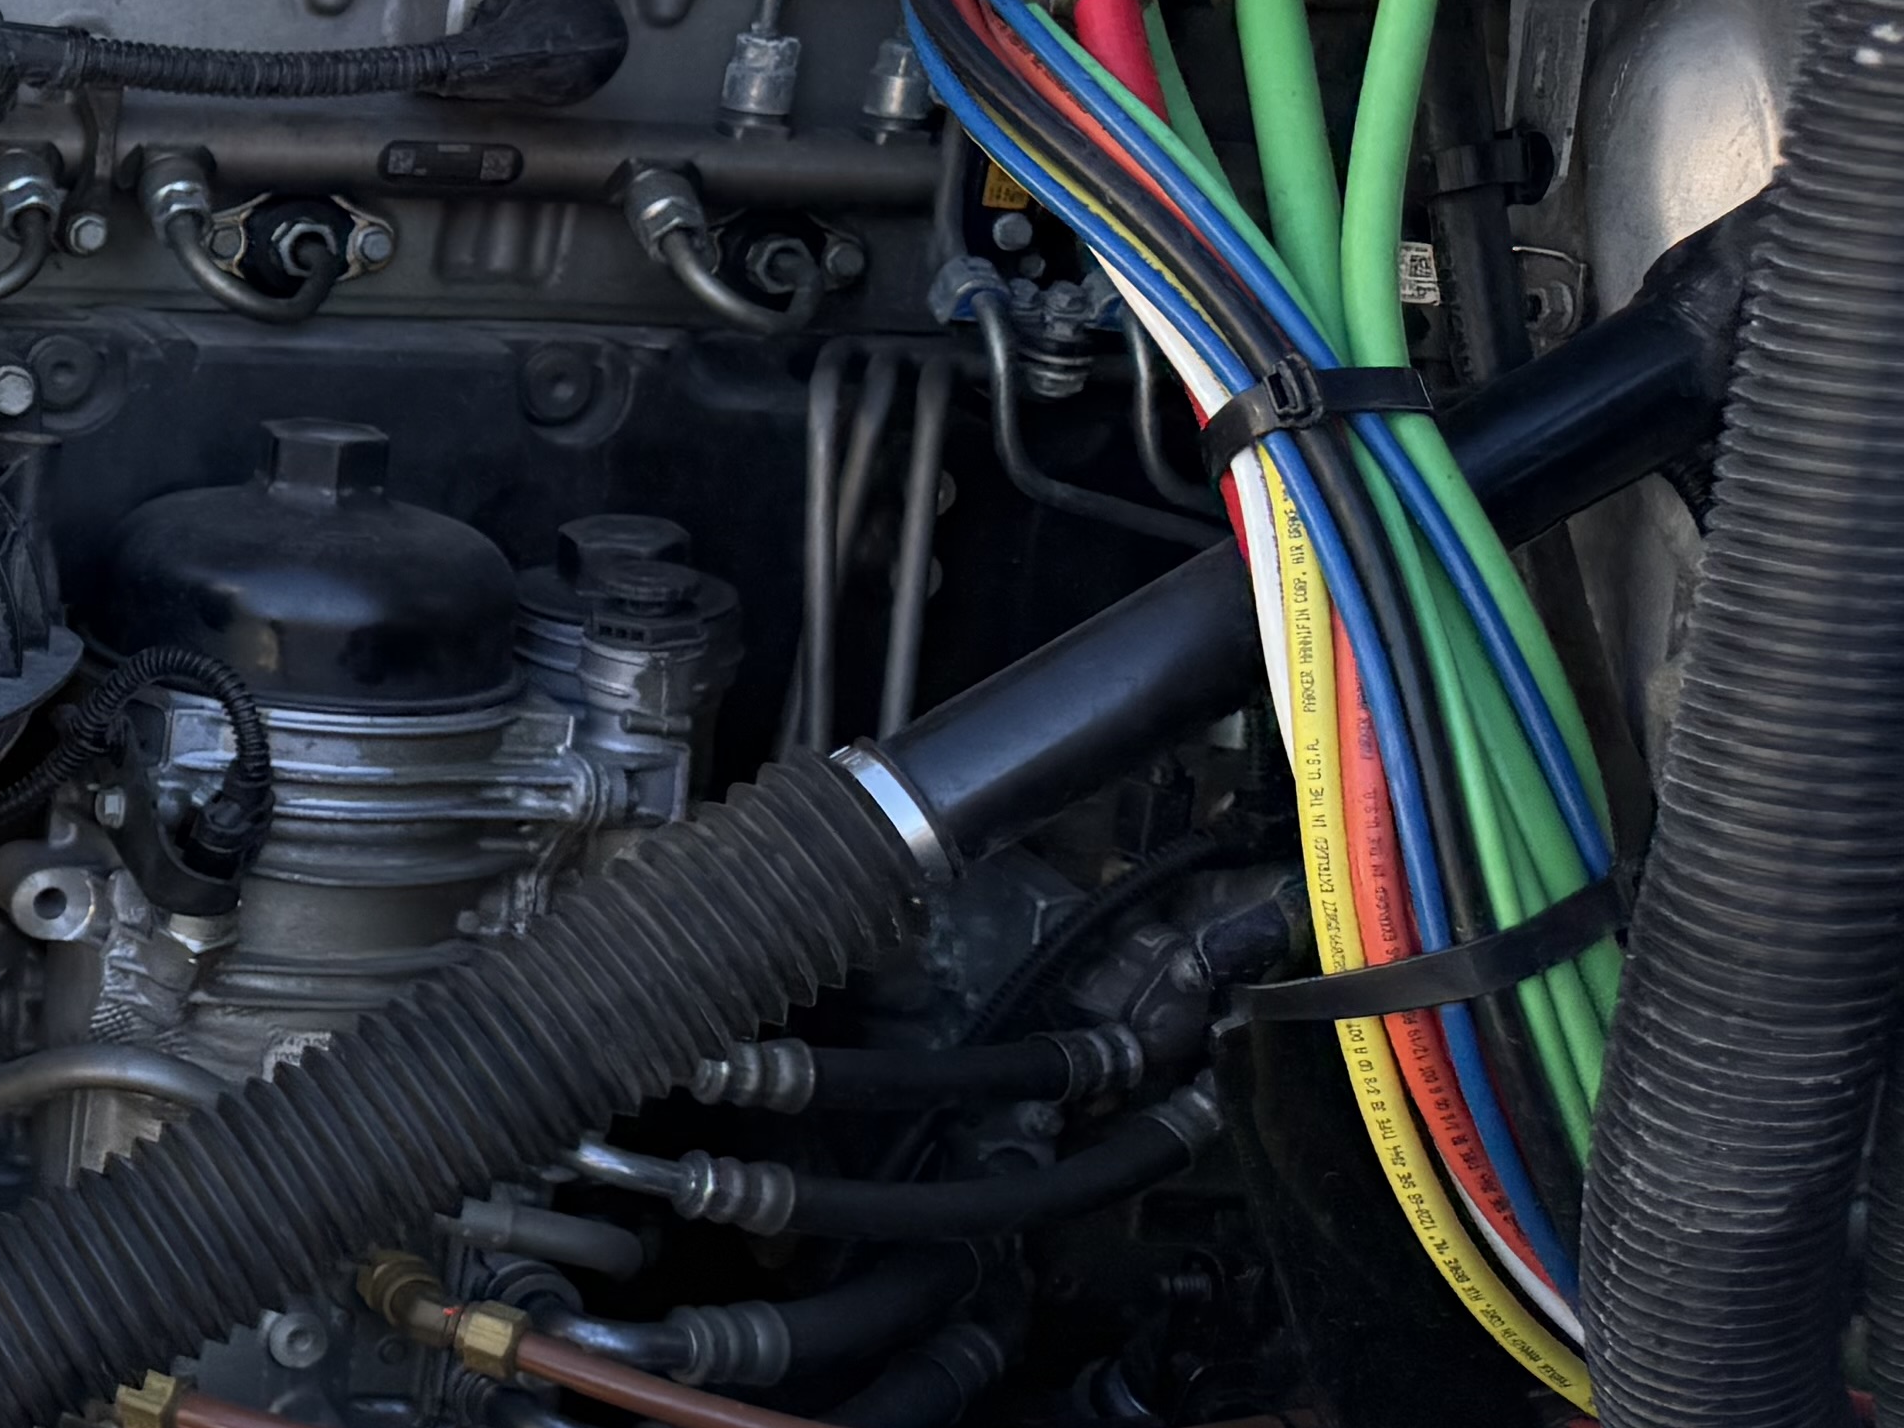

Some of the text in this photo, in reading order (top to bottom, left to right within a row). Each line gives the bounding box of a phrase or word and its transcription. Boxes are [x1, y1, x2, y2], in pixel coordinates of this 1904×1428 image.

[1293, 544, 1305, 564] AIR
[1293, 571, 1309, 604] CORP.
[1295, 609, 1314, 665] HANNIFIN
[1303, 671, 1316, 713] PARKER
[1310, 787, 1325, 812] THE
[1312, 813, 1328, 830] IN
[1376, 1115, 1396, 1142] TYPE
[1398, 1171, 1418, 1190] SAE
